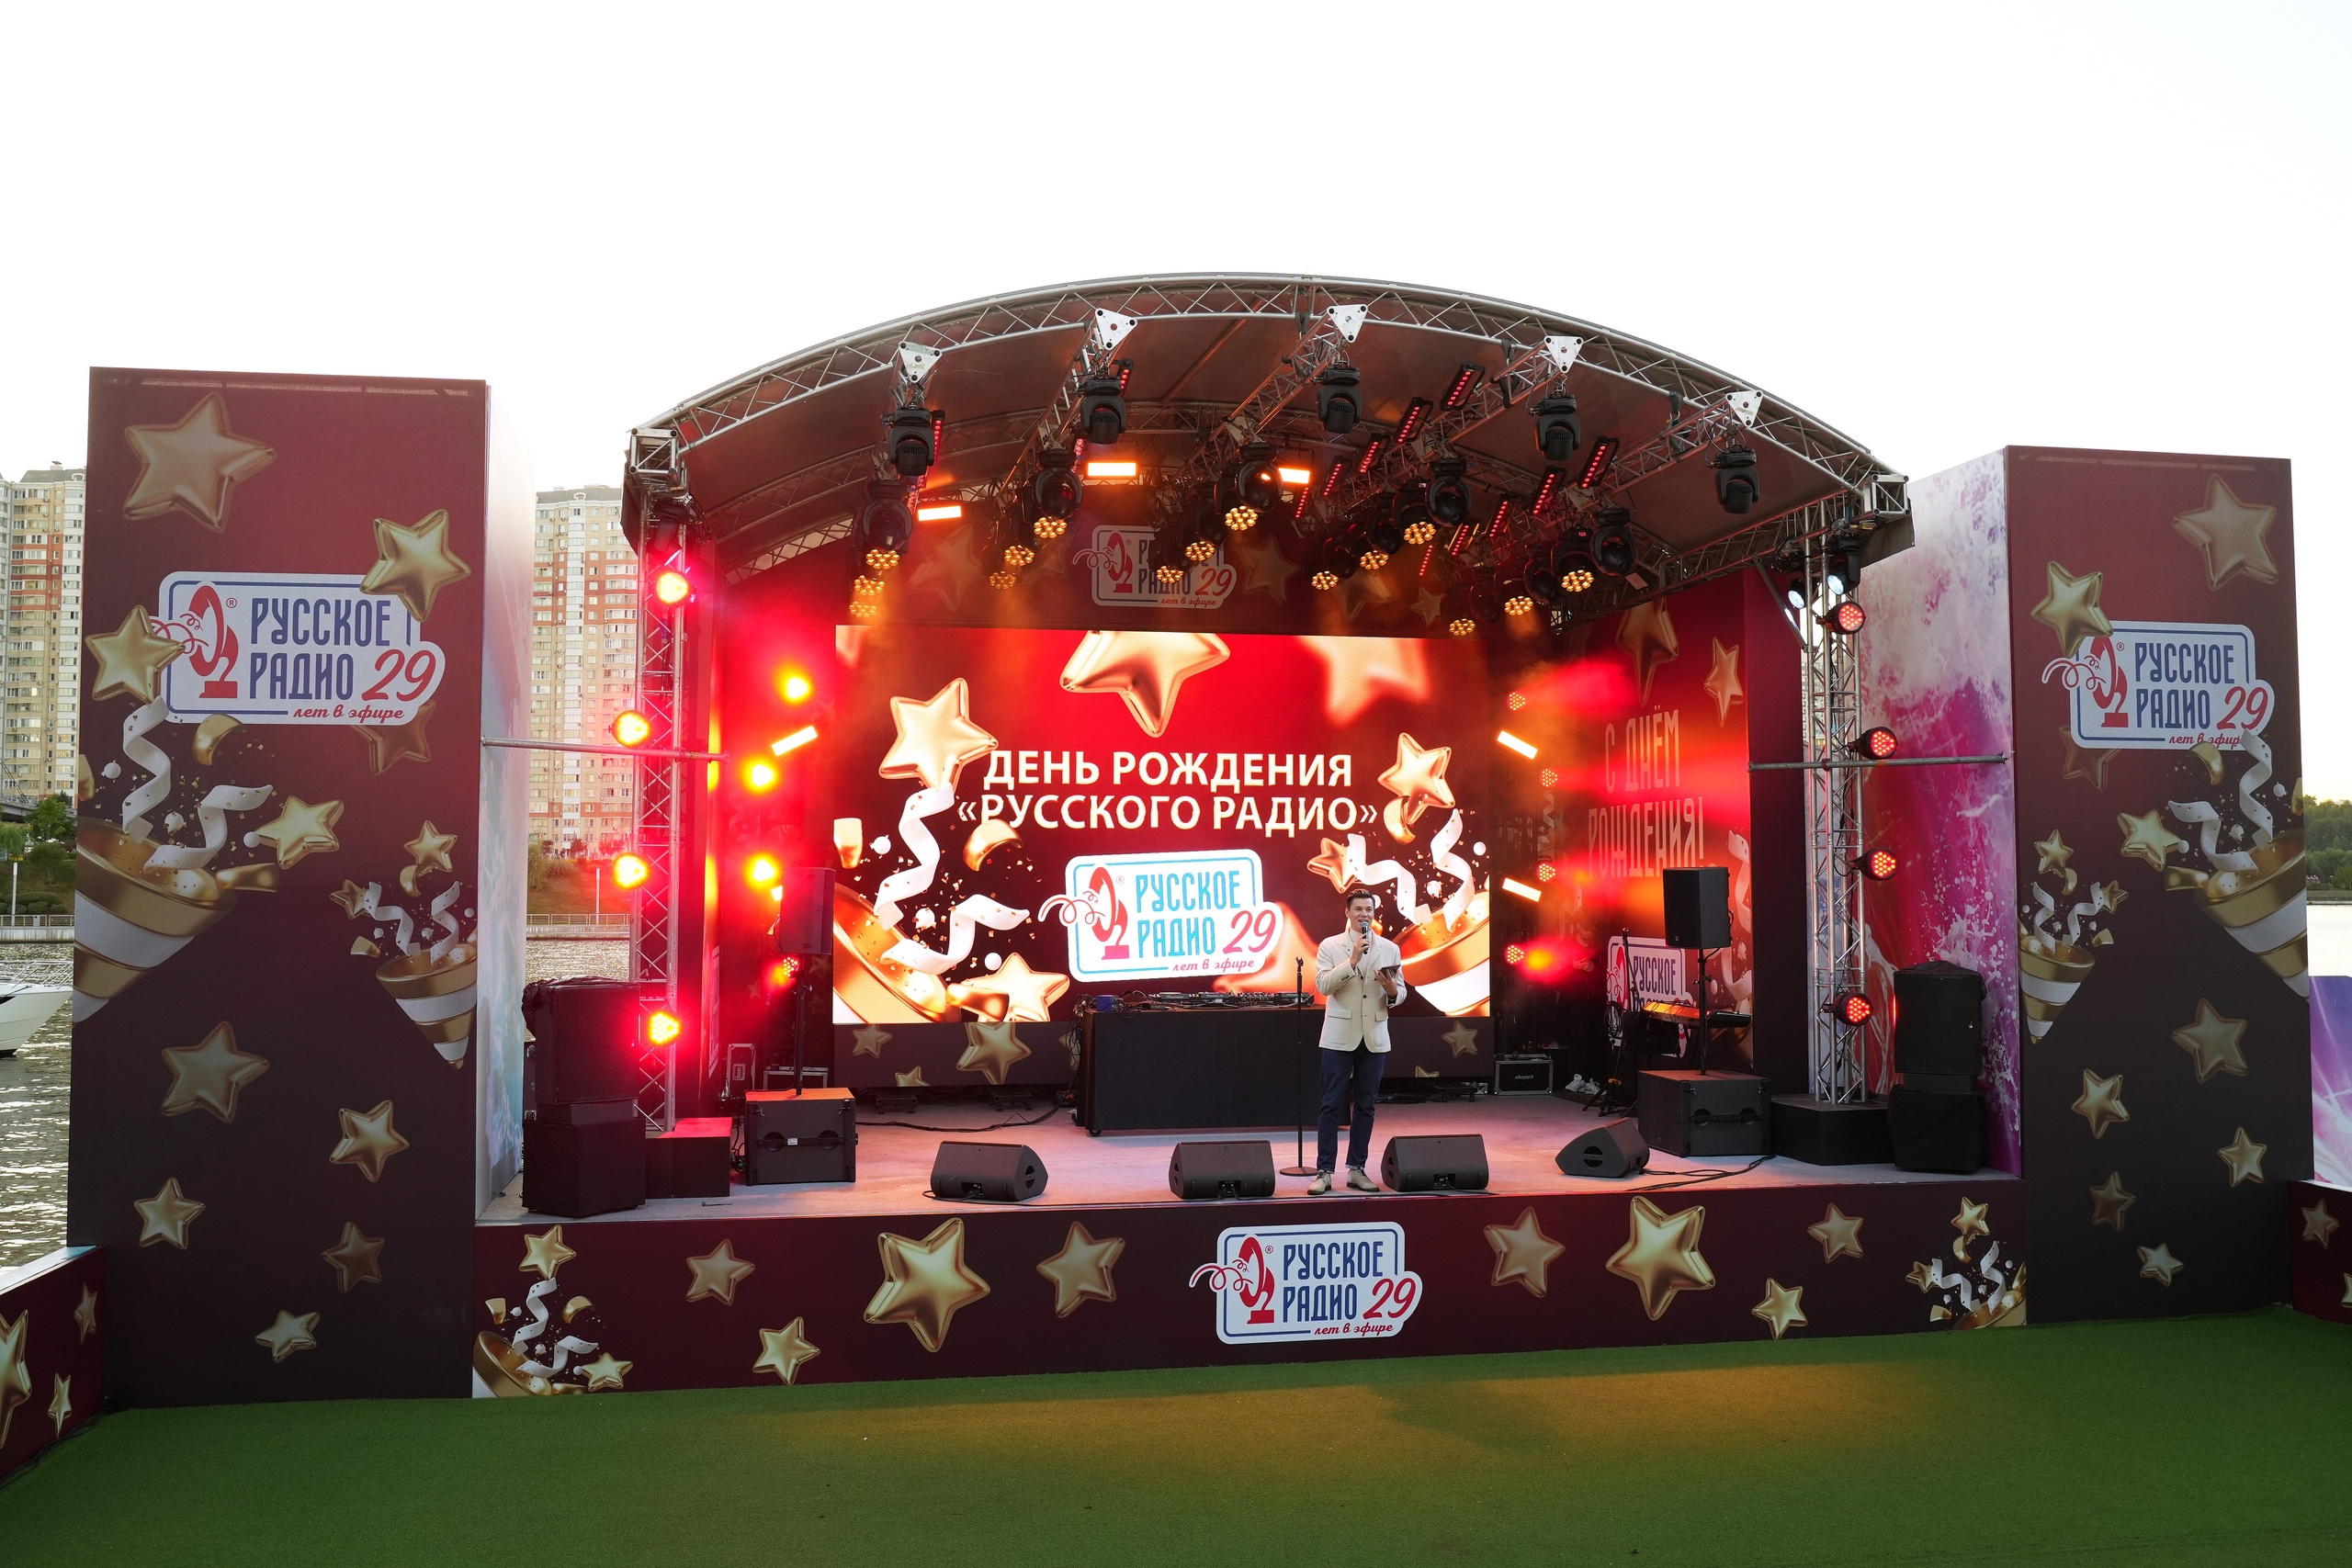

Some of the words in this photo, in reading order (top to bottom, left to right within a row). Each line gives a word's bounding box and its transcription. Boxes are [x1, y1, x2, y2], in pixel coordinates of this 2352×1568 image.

[1181, 596, 1187, 604] в
[1188, 597, 1217, 607] эфире
[1194, 568, 1233, 596] 29
[250, 597, 391, 647] РУССКОЕ
[249, 652, 354, 701] РАДИО
[361, 649, 436, 702] 29
[2134, 642, 2235, 684] РУССКОЕ
[292, 705, 332, 719] лет
[333, 705, 345, 718] в
[347, 704, 405, 722] эфире
[2136, 688, 2211, 729] РАДИО
[2216, 685, 2268, 730] 29
[1604, 722, 1616, 795] С
[1624, 704, 1680, 793] ДНЁМ
[2168, 736, 2195, 744] лет
[2208, 732, 2242, 750] эфир
[982, 750, 1101, 790] ДЕНЬ
[1113, 750, 1352, 794] РОЖДЕНИЯ
[959, 794, 1201, 830] «РУССКОГО
[1213, 795, 1378, 838] РАДИО»
[1588, 796, 1704, 879] РОЖДЕНИЯ!
[1136, 869, 1242, 914] РУССКОЕ
[1137, 917, 1216, 959] РАДИО
[1222, 908, 1276, 954] 29
[1172, 963, 1198, 971] лет
[1202, 958, 1211, 970] в
[1214, 957, 1255, 973] эфире
[1283, 1241, 1384, 1280] РУССКОЕ
[1283, 1283, 1358, 1323] РАДИО
[1363, 1277, 1417, 1319] 29
[1314, 1324, 1340, 1336] лет
[1342, 1323, 1351, 1334] в
[1353, 1323, 1394, 1337] эфире
